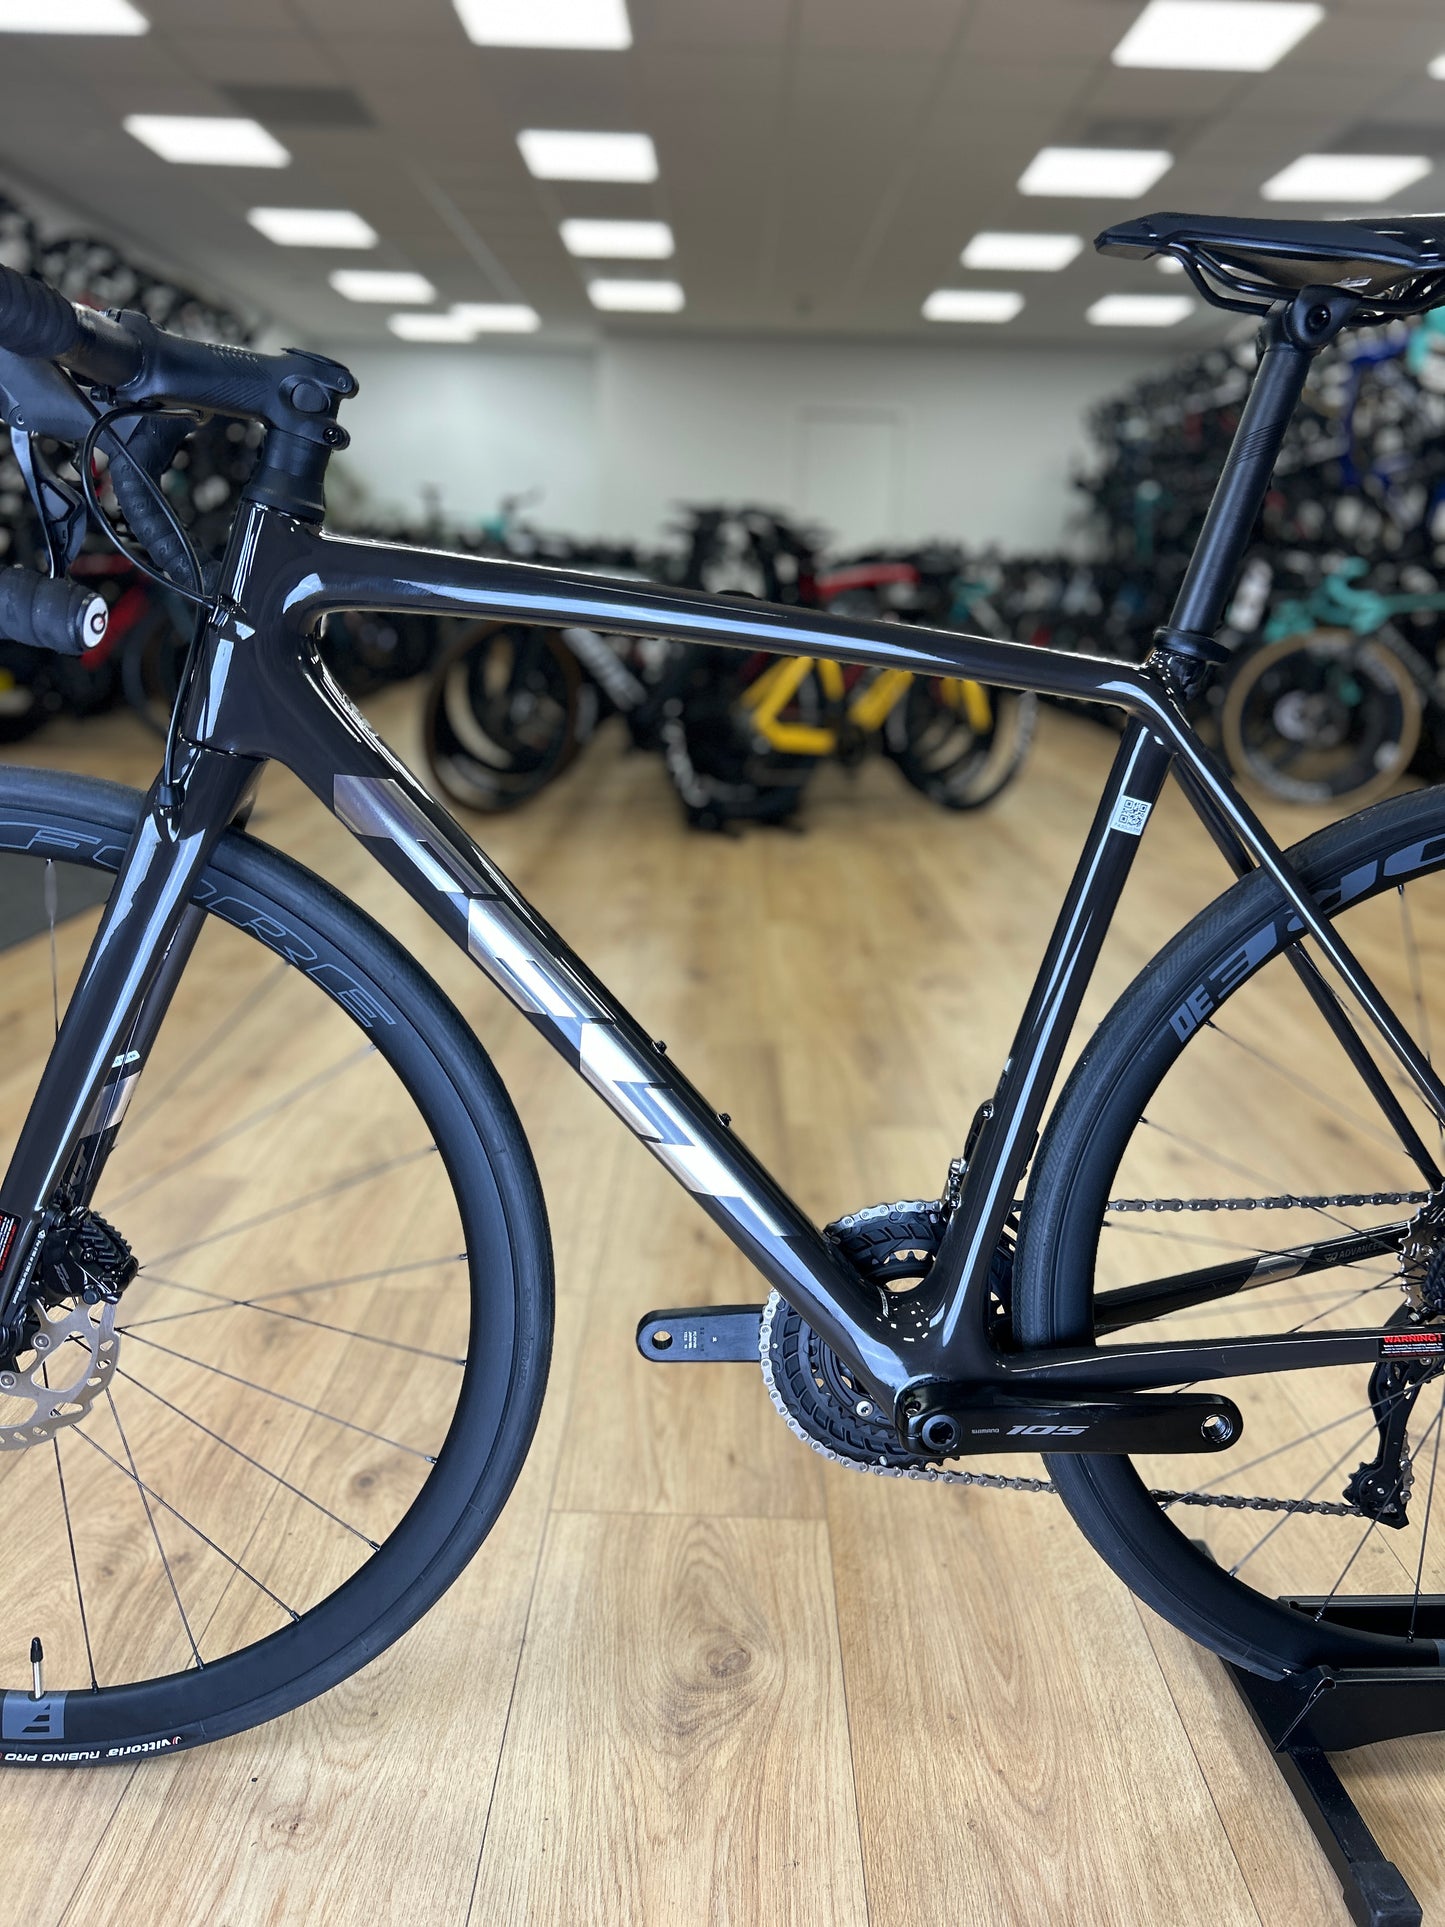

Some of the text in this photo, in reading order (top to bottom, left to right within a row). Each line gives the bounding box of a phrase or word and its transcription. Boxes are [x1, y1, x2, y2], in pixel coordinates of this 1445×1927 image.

[1006, 1425, 1090, 1435] 105
[4, 1738, 172, 1762] vittoria RUBINO PRO
